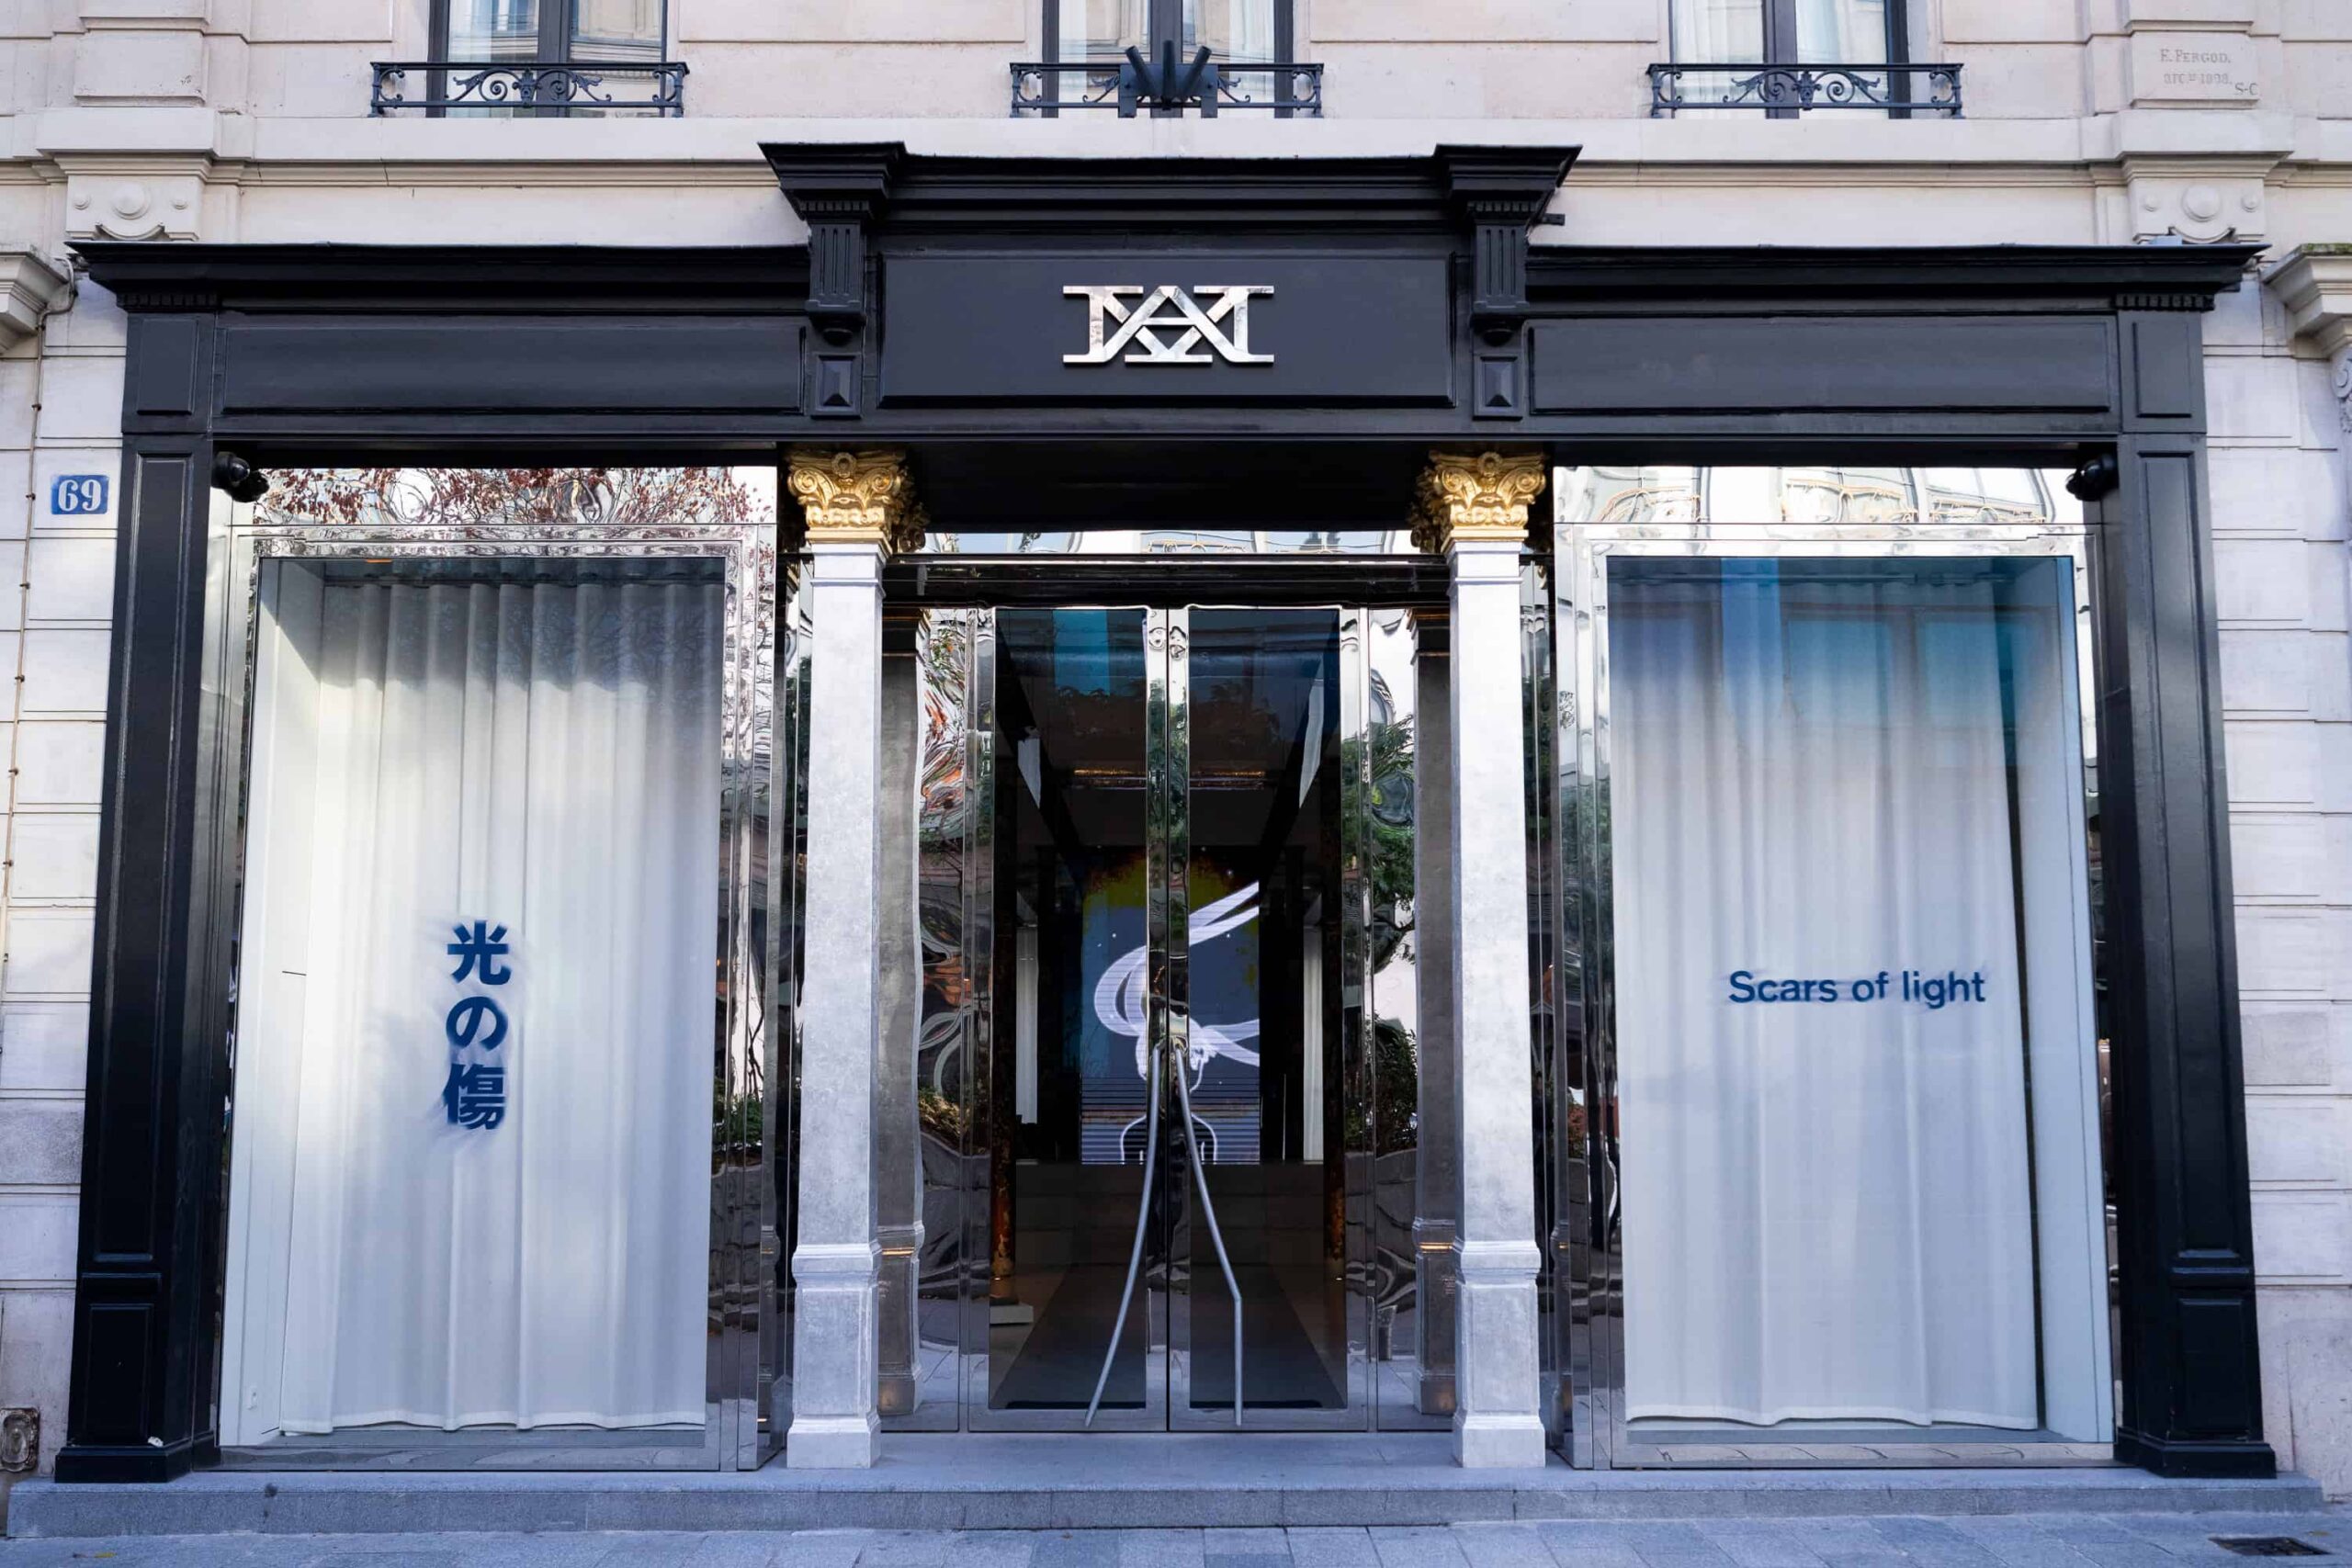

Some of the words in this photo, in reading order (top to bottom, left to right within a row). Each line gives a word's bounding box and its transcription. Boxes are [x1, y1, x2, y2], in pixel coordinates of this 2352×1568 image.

[58, 479, 101, 512] 69
[1728, 970, 1838, 1003] Scars
[1851, 971, 1890, 1002] of
[1903, 971, 1986, 1010] light
[443, 919, 512, 1130] 光の傷
